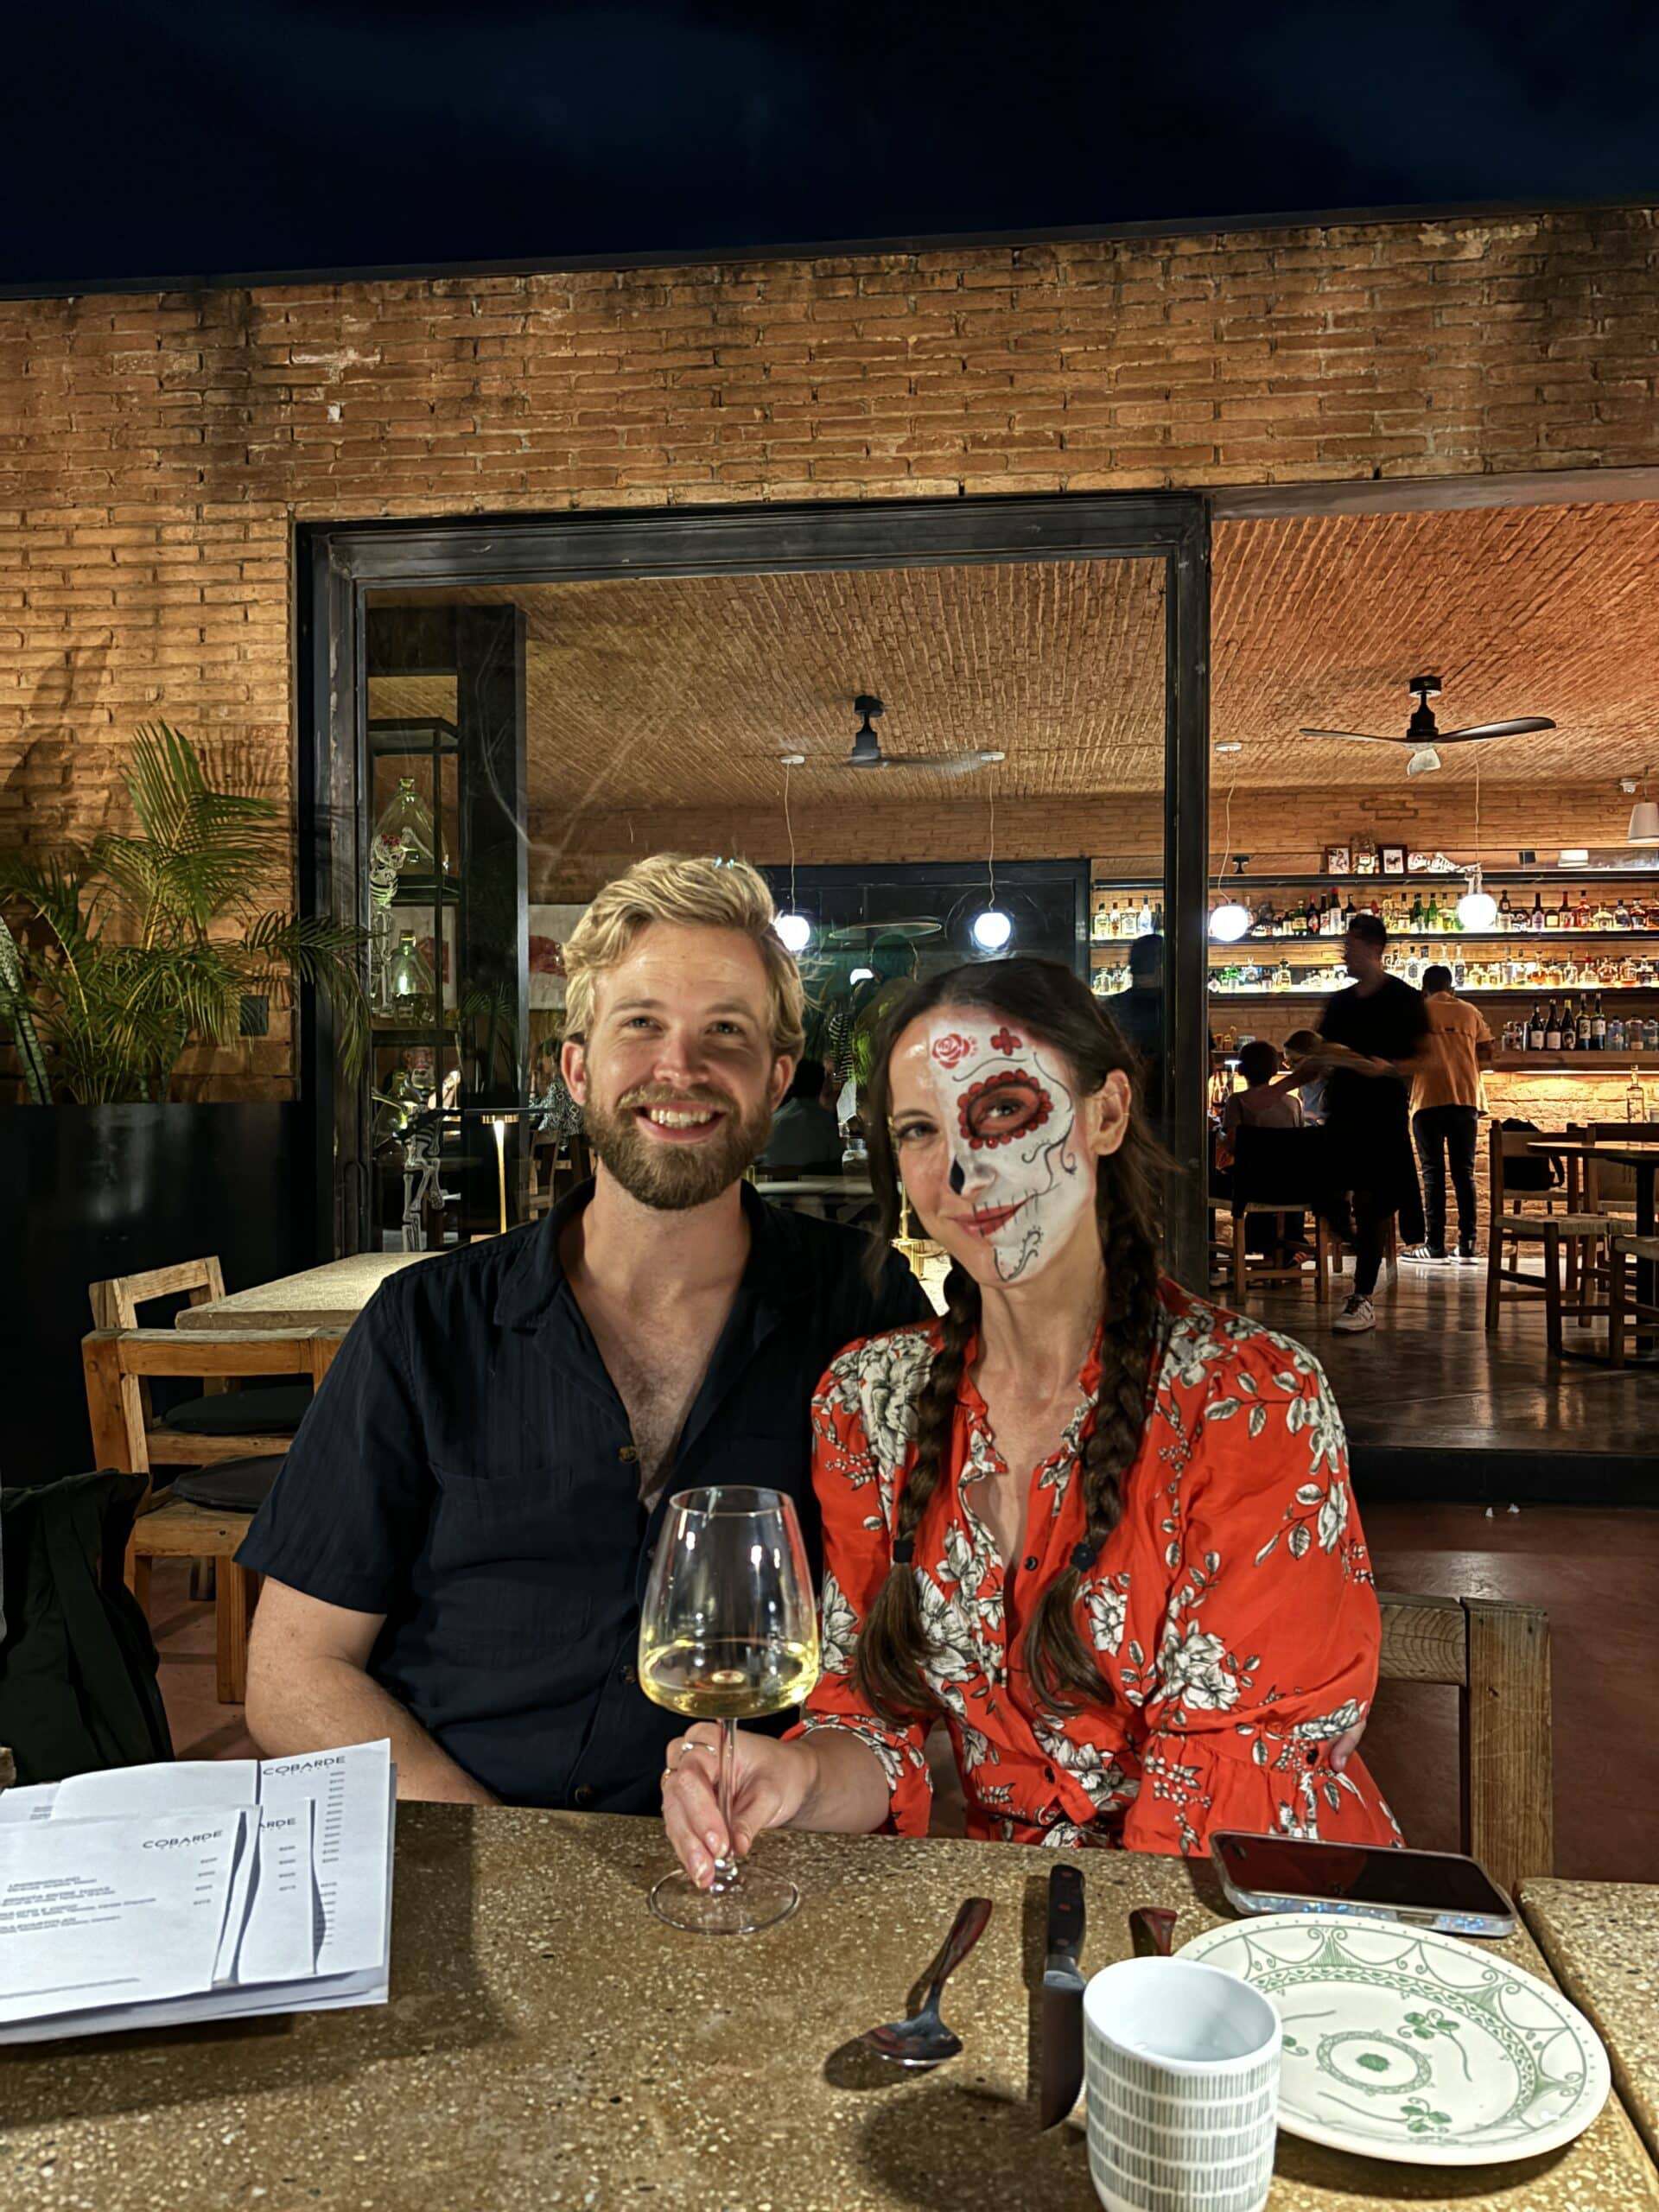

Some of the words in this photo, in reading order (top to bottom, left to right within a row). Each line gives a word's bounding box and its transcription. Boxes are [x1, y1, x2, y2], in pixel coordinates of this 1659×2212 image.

[263, 1755, 346, 1776] COBARDE
[259, 1817, 297, 1829] ARDE
[142, 1829, 224, 1849] COBARDE
